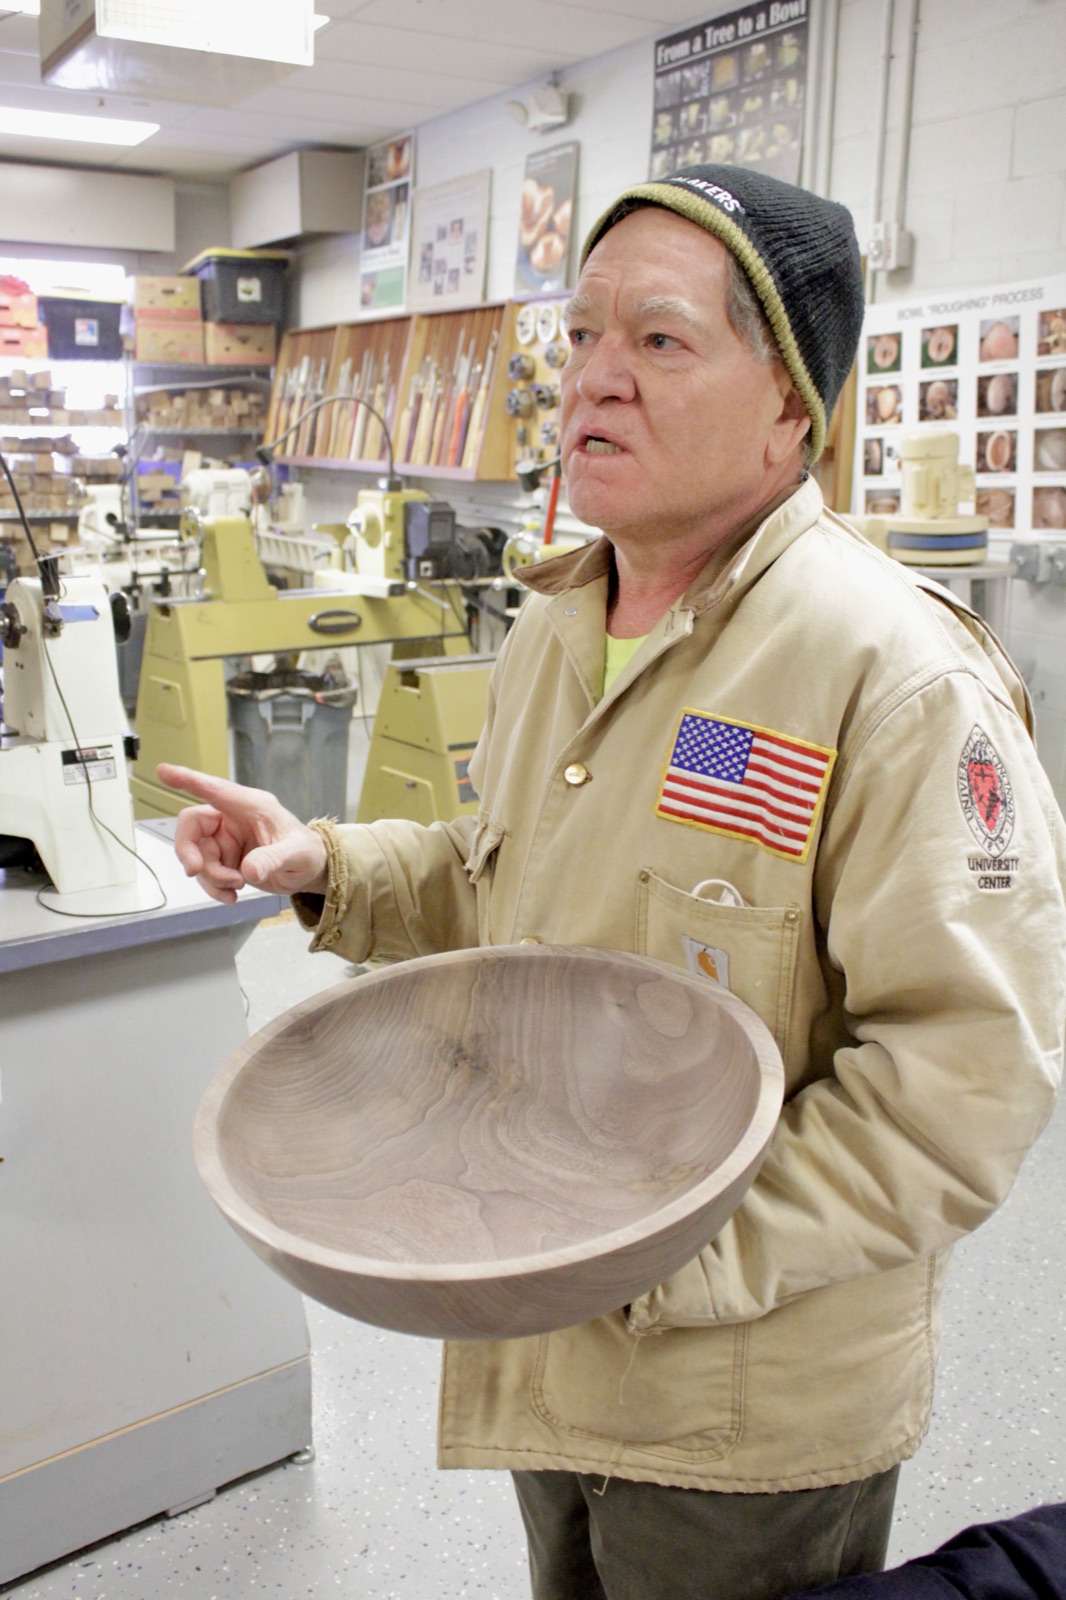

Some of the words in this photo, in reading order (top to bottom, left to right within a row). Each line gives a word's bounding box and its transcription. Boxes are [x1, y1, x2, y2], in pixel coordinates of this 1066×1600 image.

[657, 40, 690, 66] From
[692, 36, 703, 54] a
[705, 24, 735, 48] Tree
[738, 17, 753, 37] to
[756, 12, 767, 31] a
[769, 0, 806, 26] Bowl
[897, 307, 924, 321] BOWL
[992, 287, 1044, 306] PROCESS
[968, 857, 1019, 871] UNIVERSITY
[978, 876, 1011, 889] CENTER
